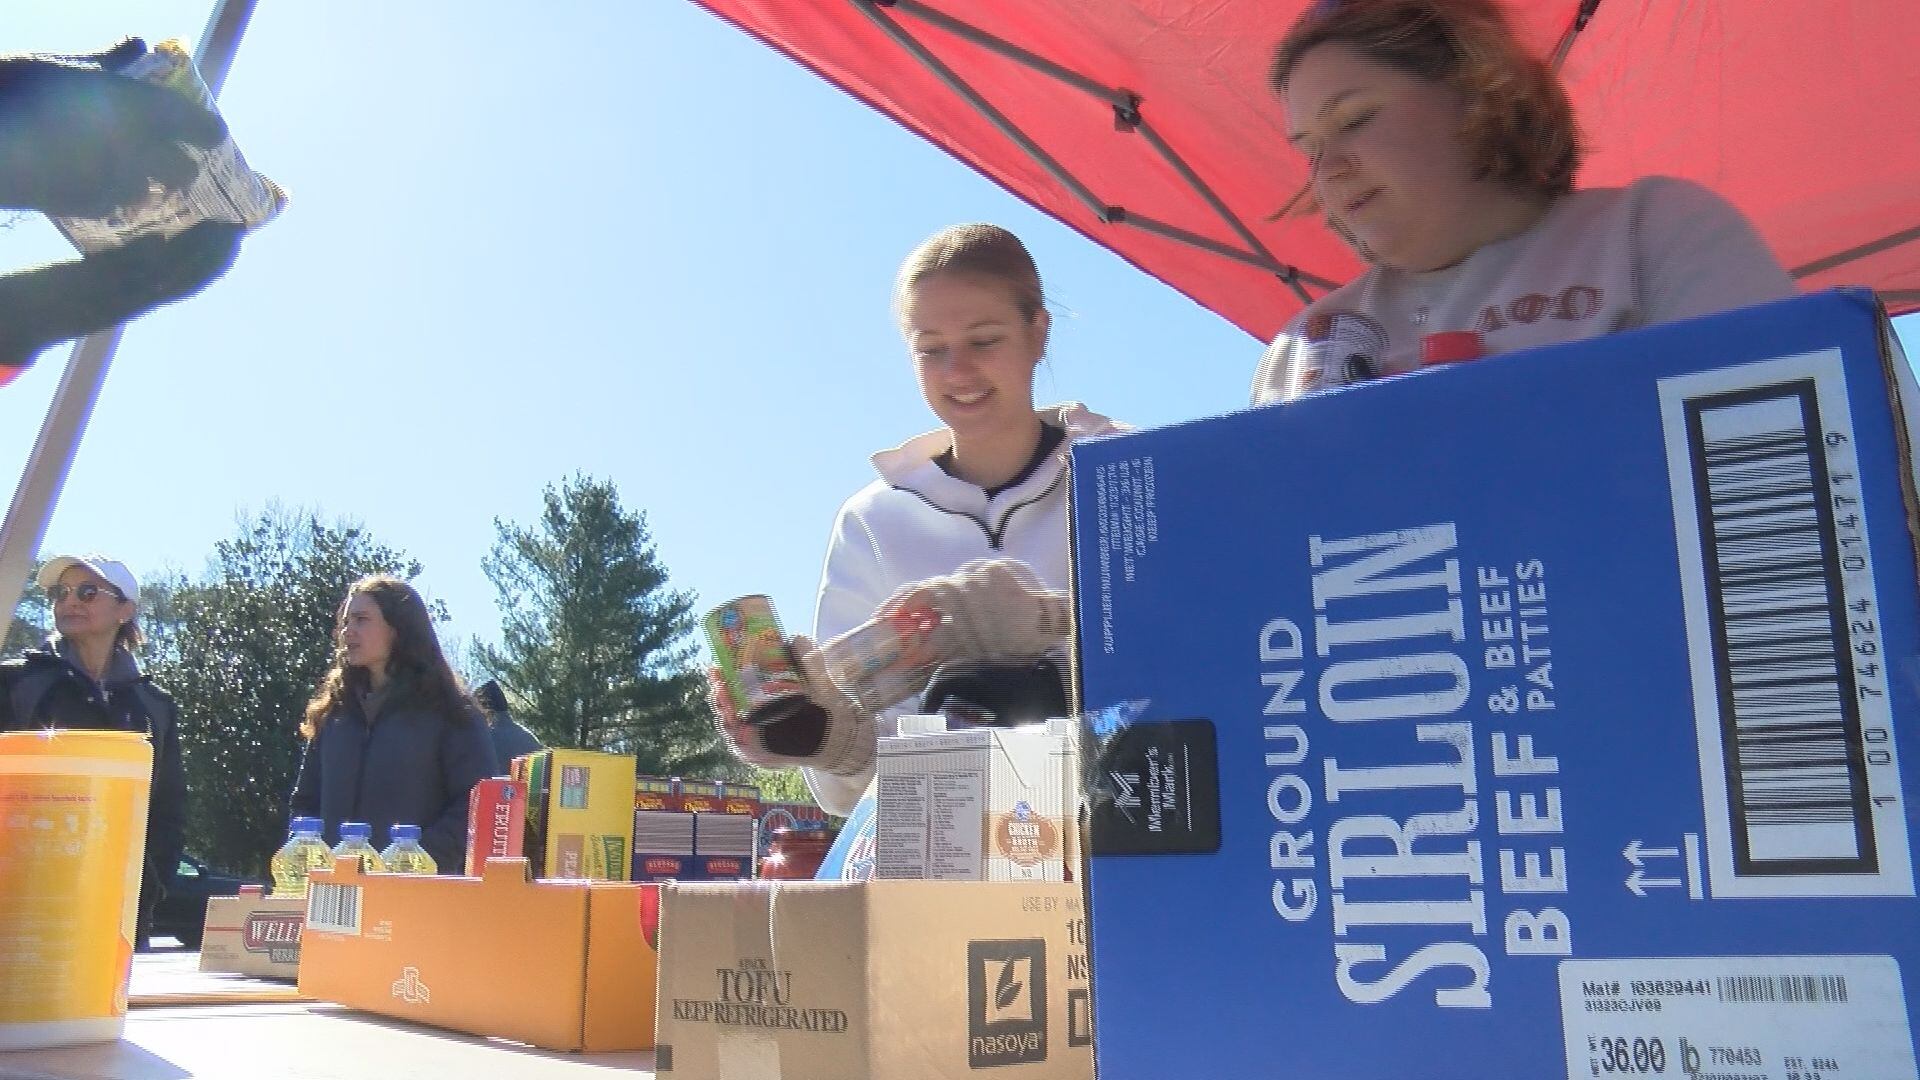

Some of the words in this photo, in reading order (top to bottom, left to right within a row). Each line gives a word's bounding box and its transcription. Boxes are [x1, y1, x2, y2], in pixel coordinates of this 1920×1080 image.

[1825, 431, 1848, 447] 9
[1120, 460, 1130, 478] LB
[1121, 479, 1131, 495] 36
[1144, 456, 1157, 507] FROZEN
[1133, 478, 1144, 522] COUNT
[1122, 504, 1134, 555] WEIGHT
[1135, 523, 1147, 558] CASE
[1147, 509, 1159, 543] KEEP
[1100, 536, 1112, 593] NUMBER
[1125, 557, 1136, 583] NET
[1103, 594, 1115, 655] SUPPLIER
[1477, 566, 1516, 670] BEEF
[1515, 558, 1556, 712] PATTIES
[1848, 597, 1884, 702] 74624
[1488, 685, 1519, 713] &
[1309, 521, 1492, 1008] SIRLOIN
[1864, 728, 1892, 767] 00
[1259, 617, 1318, 922] GROUND
[1145, 746, 1162, 832] Member's
[1873, 795, 1897, 809] 1
[1007, 822, 1041, 837] CHICKEN
[1491, 731, 1573, 956] BEEF
[1022, 897, 1041, 911] USE
[1045, 896, 1058, 911] BY
[716, 969, 792, 1006] TOFU
[1582, 980, 1621, 998] Mat#
[1631, 979, 1712, 997] 103629441
[1584, 999, 1662, 1012] 31323CJV09
[972, 1032, 1039, 1056] nasoya
[1600, 1036, 1666, 1074] 36.00
[1678, 1036, 1701, 1074] lb
[1708, 1047, 1763, 1066] 770453
